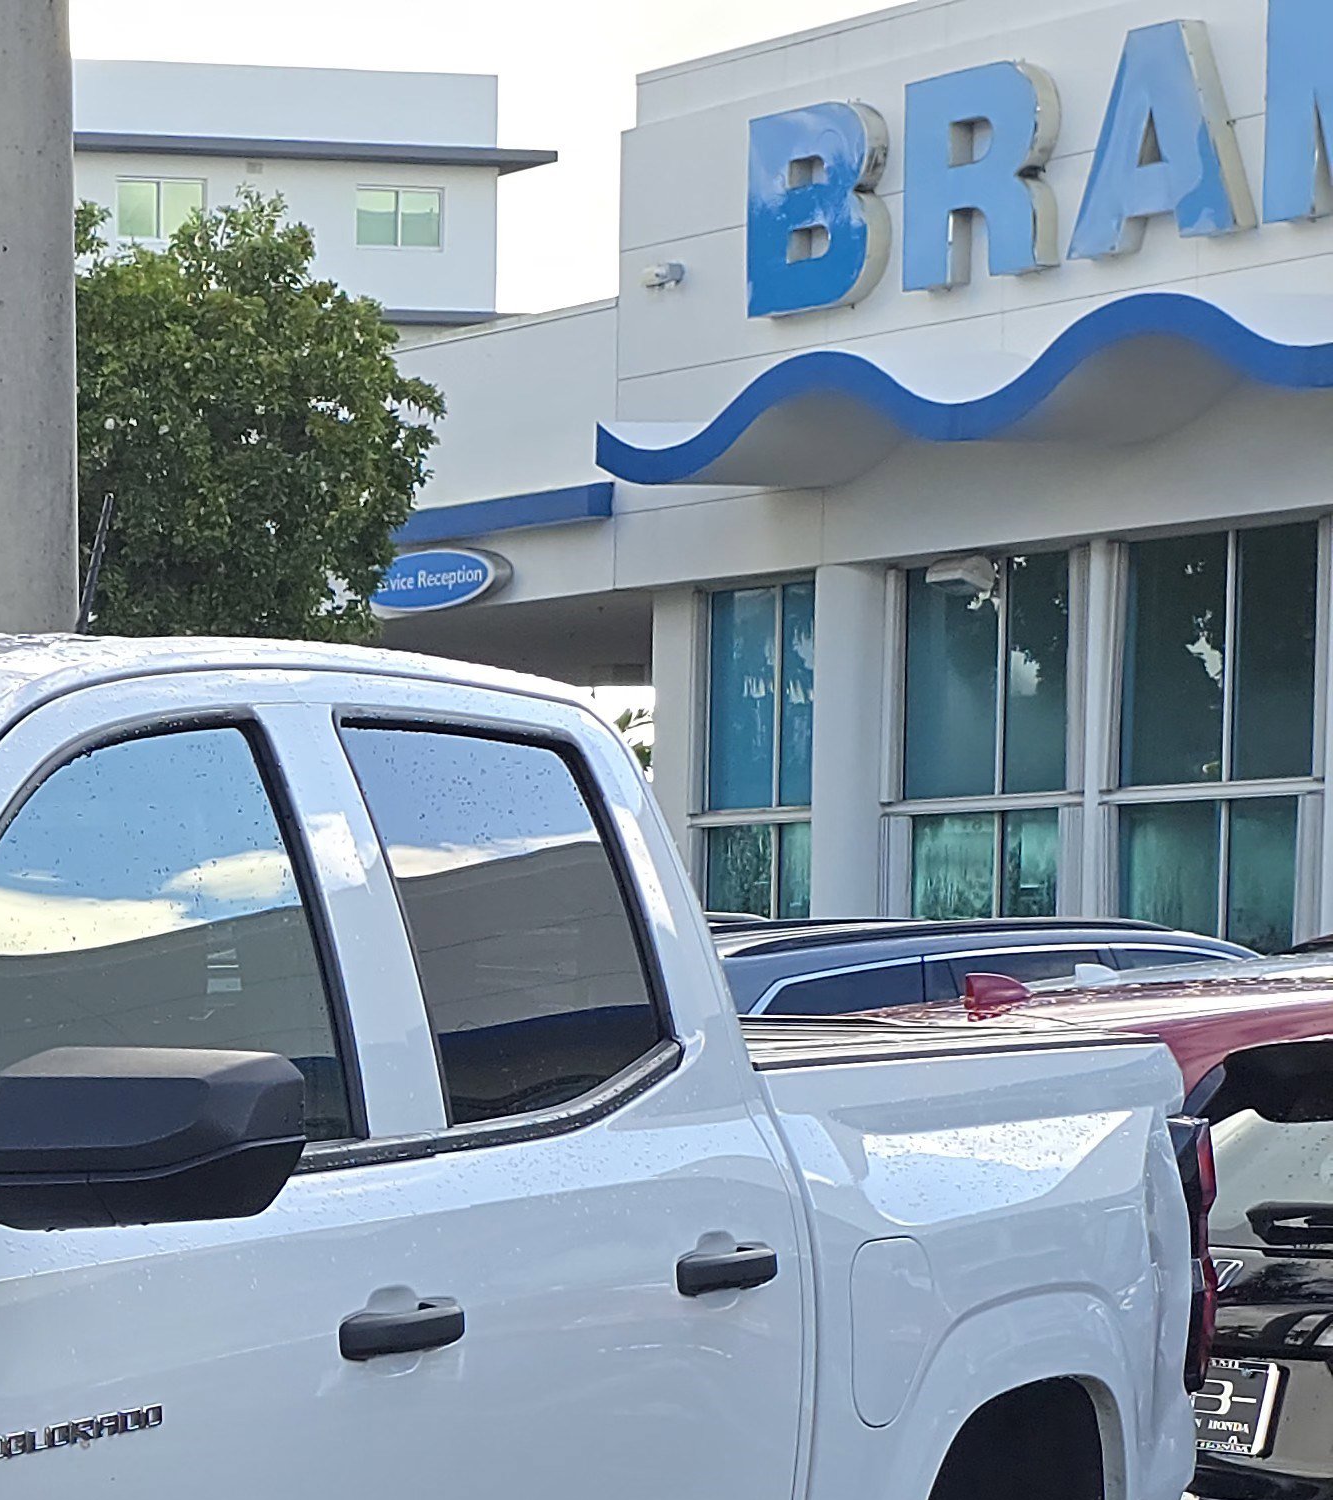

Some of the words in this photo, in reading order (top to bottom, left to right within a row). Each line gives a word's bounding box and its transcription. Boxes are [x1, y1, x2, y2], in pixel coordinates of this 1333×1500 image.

[376, 573, 414, 592] vice
[417, 565, 483, 591] Reception
[1208, 1419, 1250, 1434] HONDA
